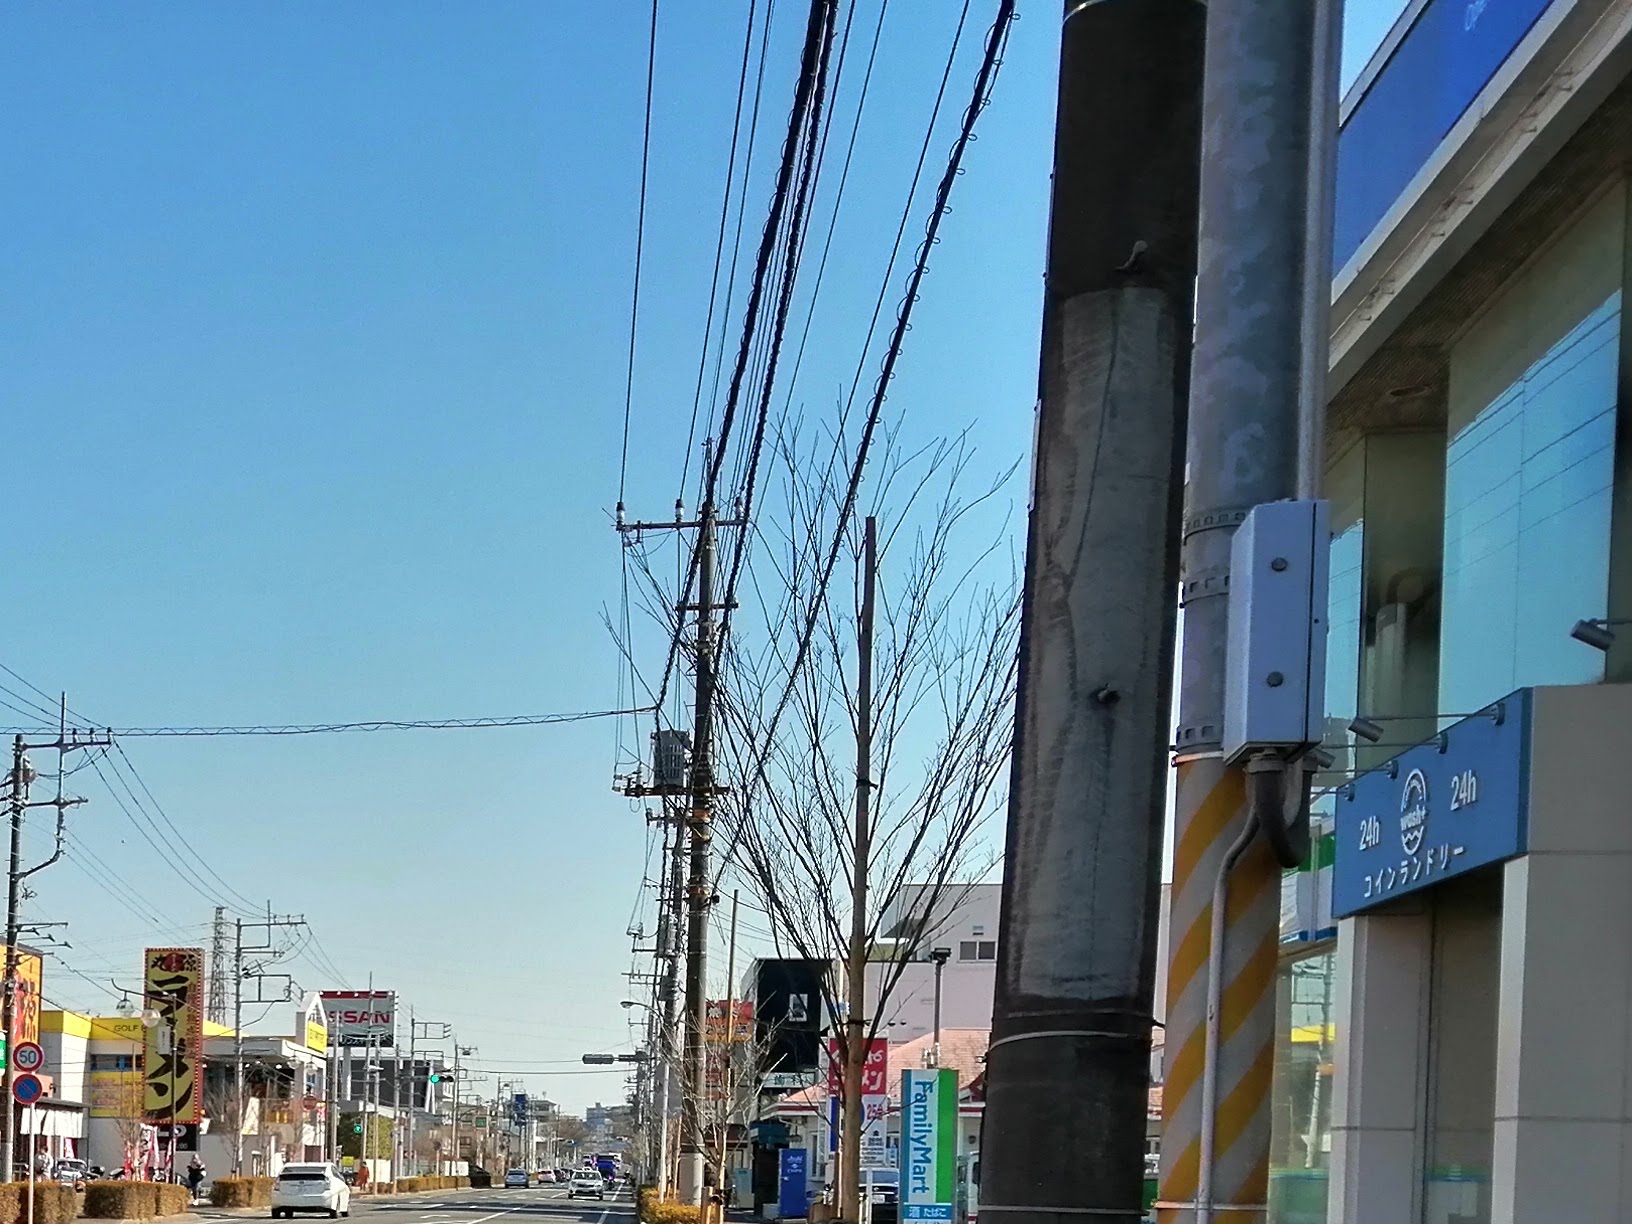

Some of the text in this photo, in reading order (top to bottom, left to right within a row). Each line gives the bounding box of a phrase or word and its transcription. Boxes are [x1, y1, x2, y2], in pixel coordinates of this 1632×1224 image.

[1450, 769, 1477, 812] 24h
[1359, 815, 1380, 850] 24h
[1364, 843, 1464, 898] コインランドリー
[114, 1024, 139, 1032] GOLF
[328, 1010, 390, 1024] SSAN
[19, 1050, 37, 1064] 50
[910, 1080, 934, 1194] FamilyMart
[924, 1206, 947, 1218] たばこ
